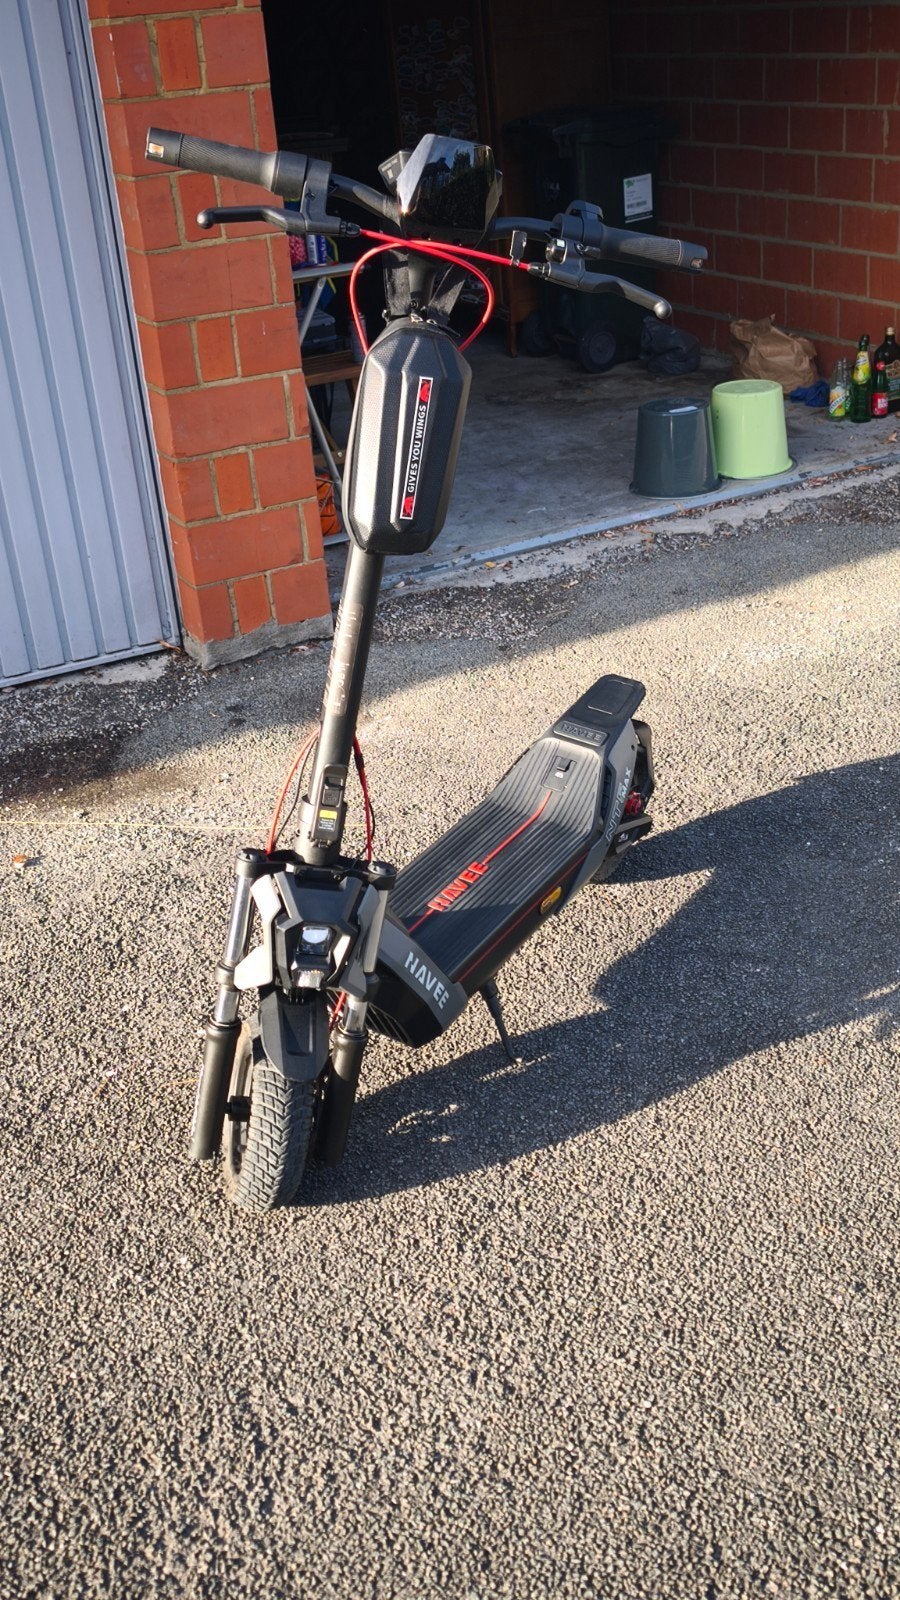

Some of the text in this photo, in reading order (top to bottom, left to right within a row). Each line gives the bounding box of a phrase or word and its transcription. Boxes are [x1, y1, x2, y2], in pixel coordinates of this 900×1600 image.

[407, 405, 427, 493] GIVES YOU WINGS
[560, 723, 602, 741] NAVEE
[427, 861, 489, 912] NAVEE
[404, 951, 450, 1010] NAVEE
